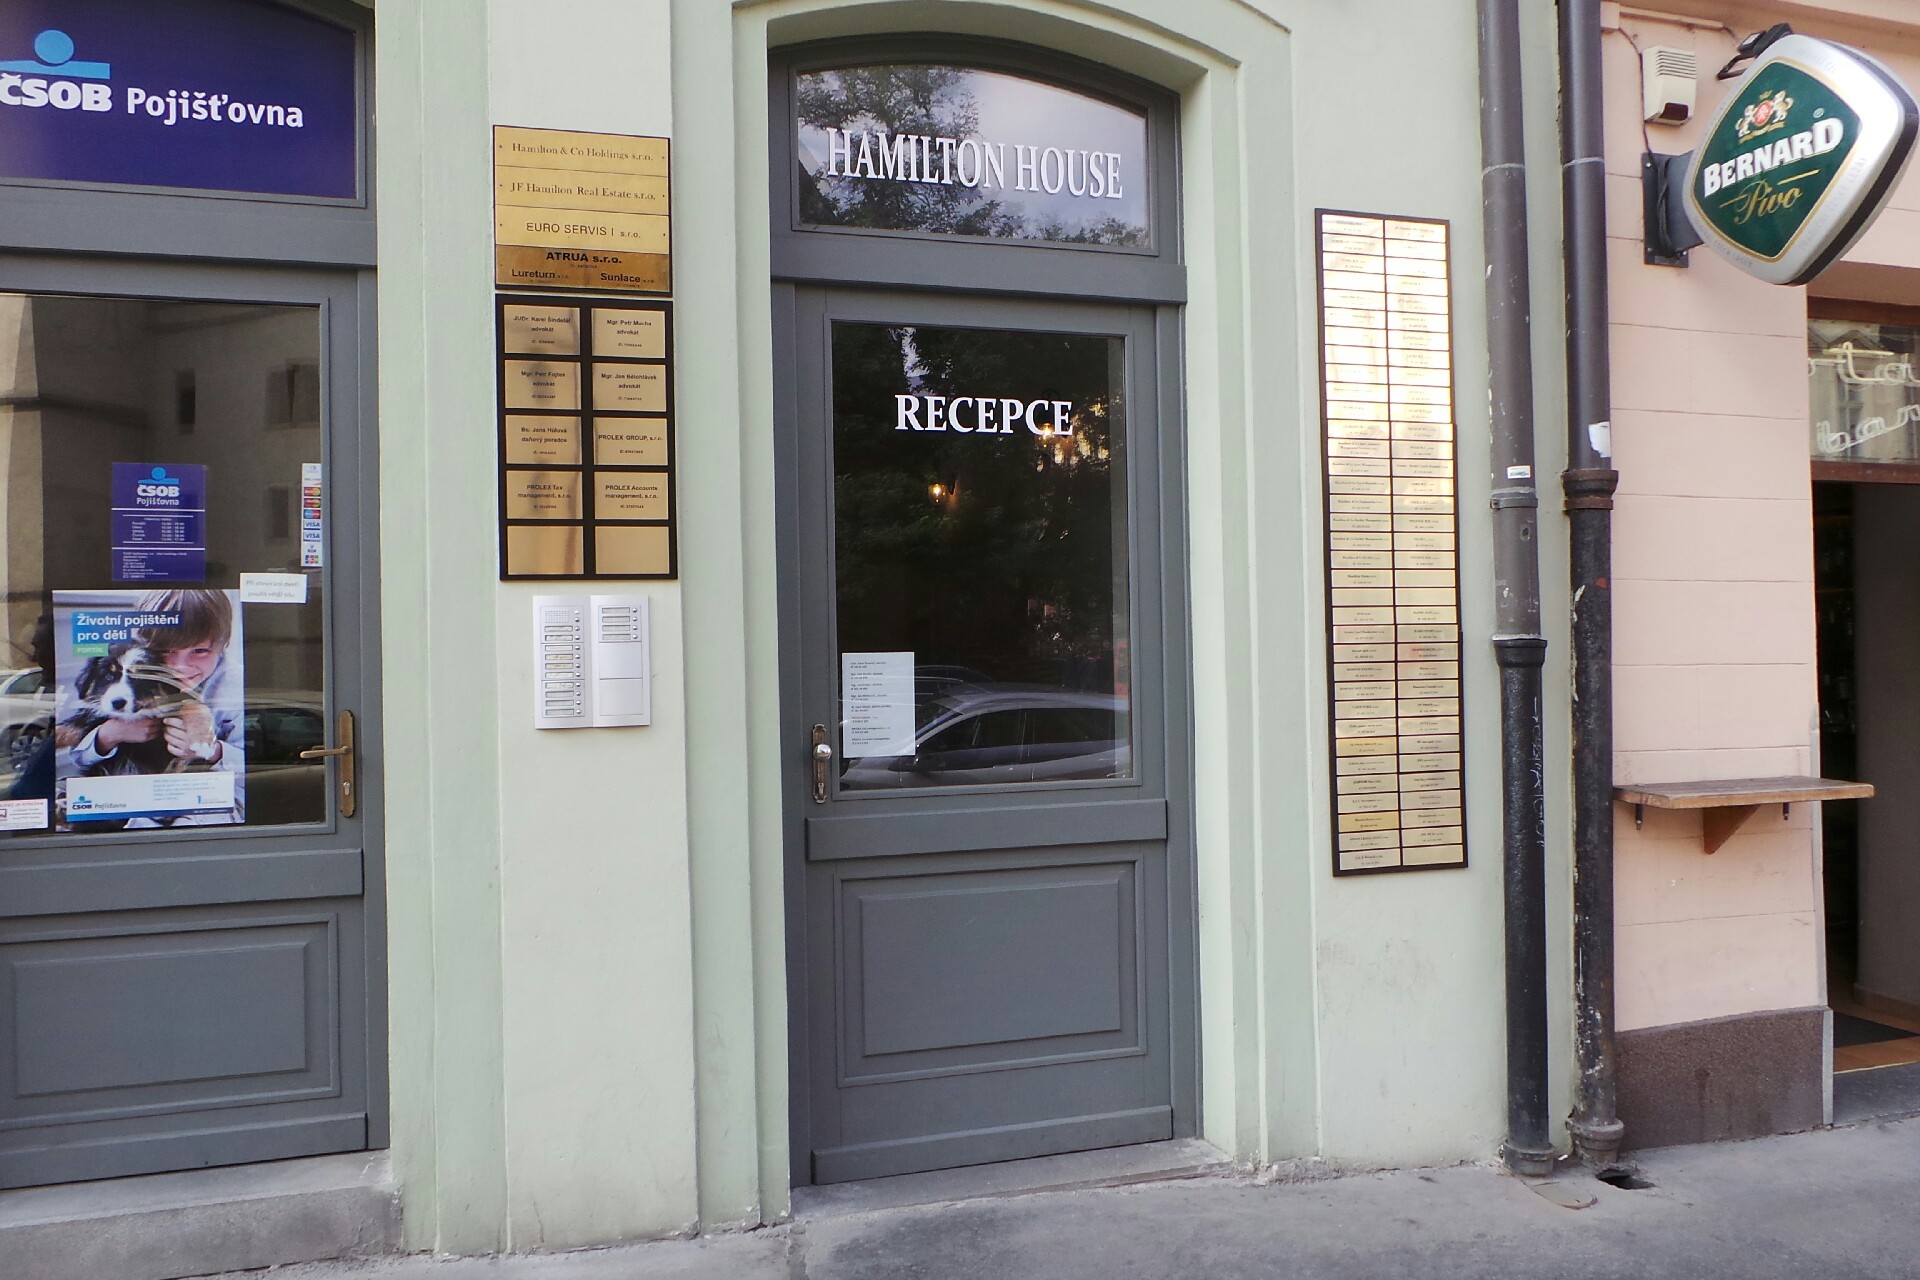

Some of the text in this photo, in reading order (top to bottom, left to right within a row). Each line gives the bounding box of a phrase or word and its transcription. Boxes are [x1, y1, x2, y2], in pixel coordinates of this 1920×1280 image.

[0, 73, 304, 128] ČSOB Pojišťovna
[512, 143, 558, 155] Hamilton
[560, 147, 568, 155] &
[571, 147, 585, 156] Co
[587, 148, 629, 161] Holdings
[1704, 117, 1844, 198] BERNARD
[826, 127, 1124, 199] HAMILTON HOUSE
[510, 182, 656, 201] JF Hamilton Real Estate s.r.o.
[1734, 178, 1803, 225] Pivo
[526, 222, 560, 234] EURO
[564, 224, 607, 236] SERVIS
[620, 231, 641, 239] s.r.o.
[545, 252, 622, 264] ATRUA s.r.o.
[511, 269, 556, 279] Lureturn
[601, 272, 641, 283] Sunlace
[895, 394, 1073, 436] RECEPCE
[137, 484, 180, 497] ČSOB
[136, 497, 180, 506] Pojišťovna
[77, 613, 179, 627] Životní pojištění
[77, 630, 127, 642] pro děti
